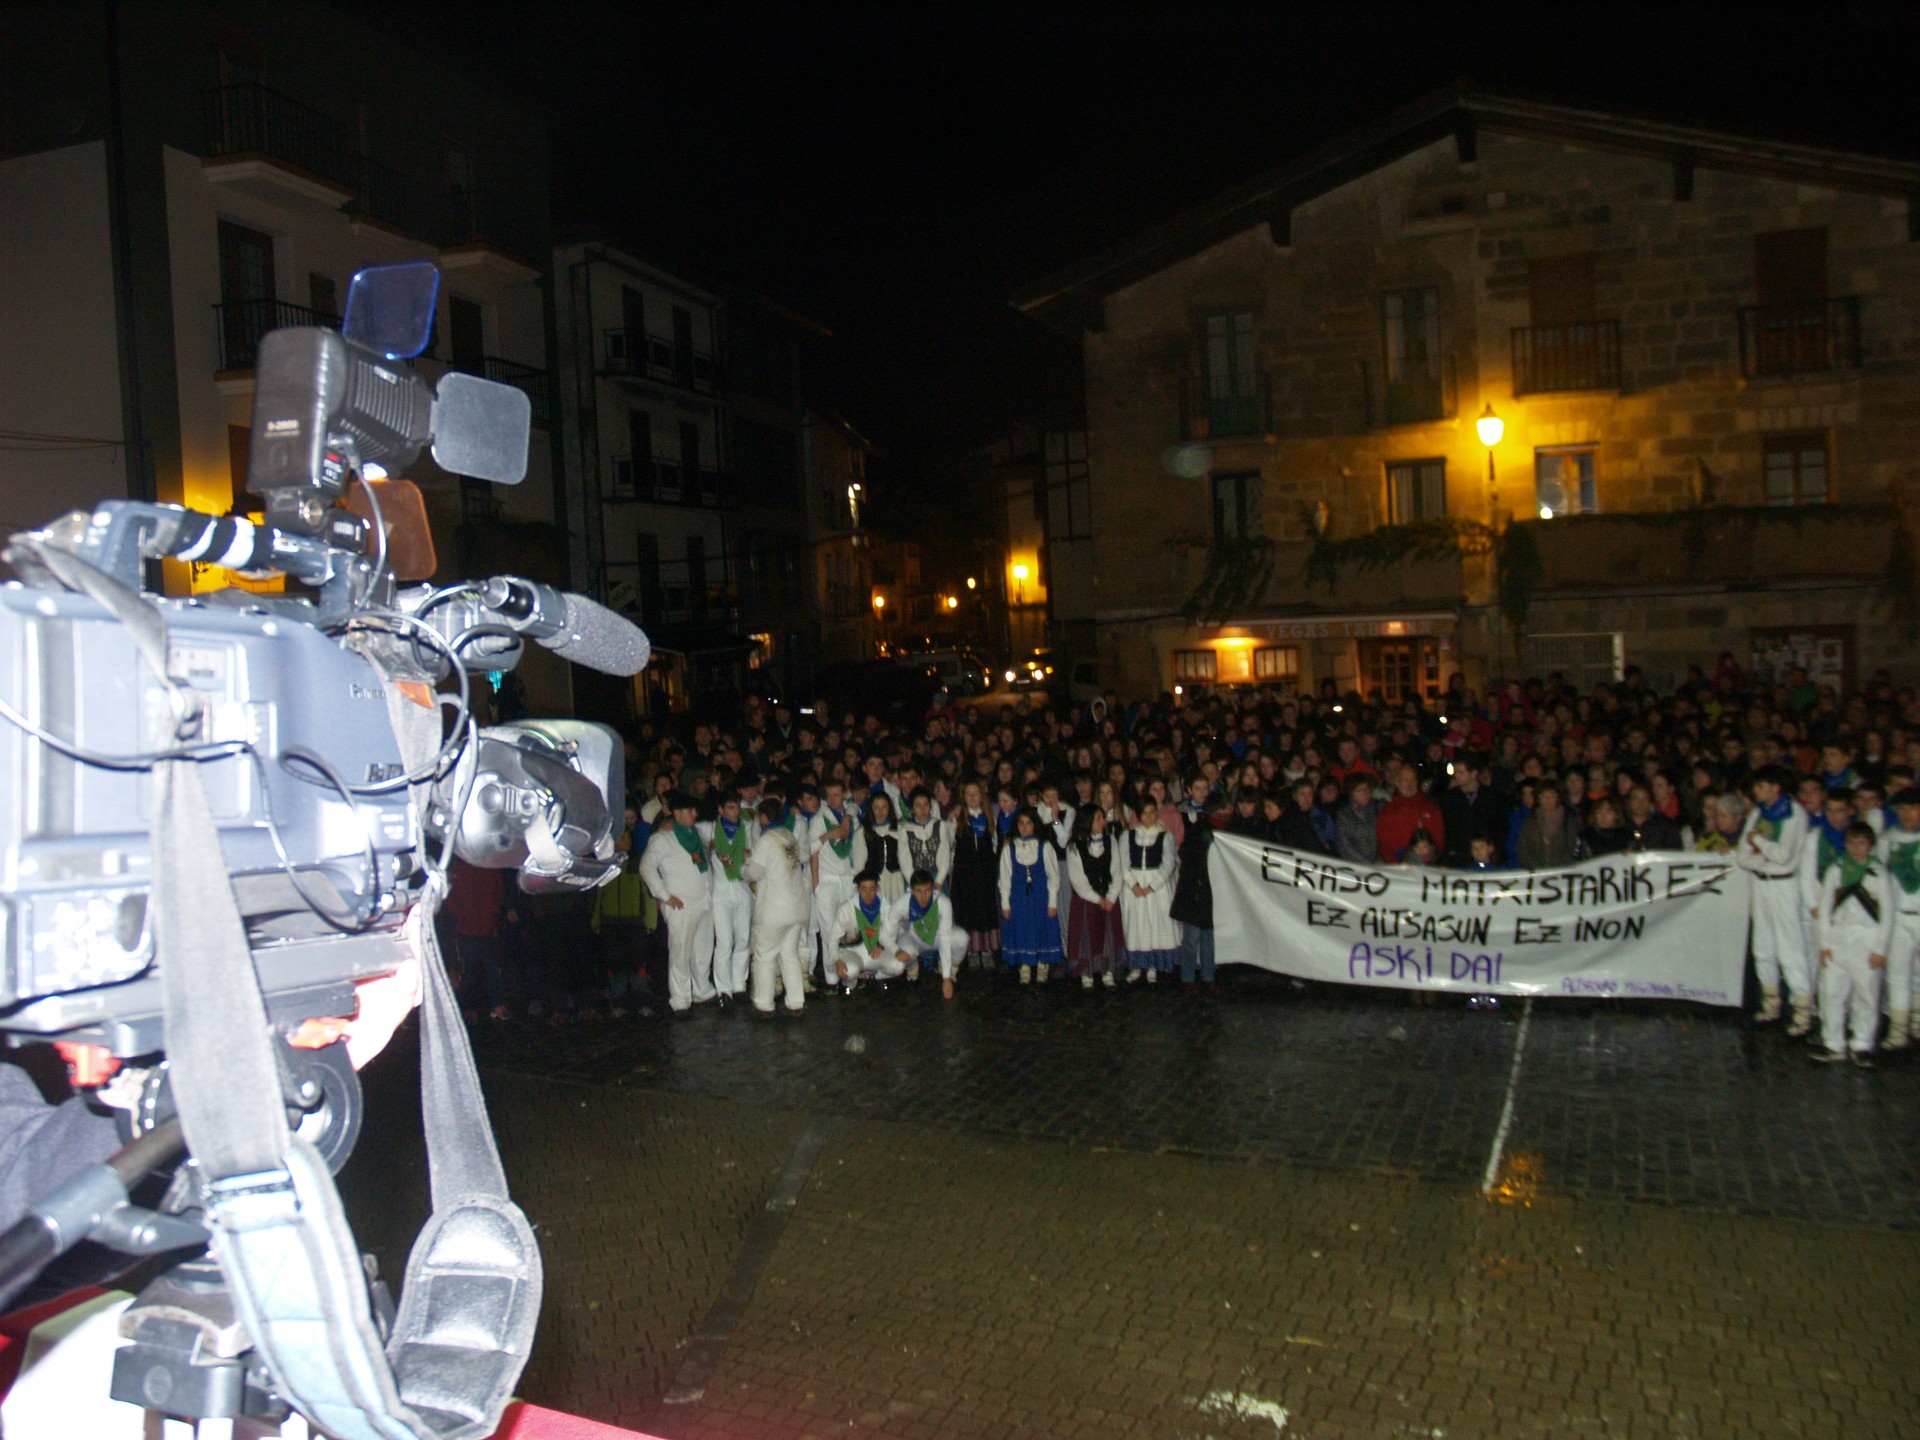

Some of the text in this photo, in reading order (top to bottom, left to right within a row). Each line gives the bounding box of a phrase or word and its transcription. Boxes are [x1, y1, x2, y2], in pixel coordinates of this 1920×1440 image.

[1266, 624, 1329, 638] VEGAS
[1262, 847, 1389, 896] ERASO
[1667, 863, 1734, 899] EZ
[1308, 900, 1351, 929] EZ
[1361, 907, 1492, 946] ALTSASUN
[1515, 915, 1562, 944] EZ
